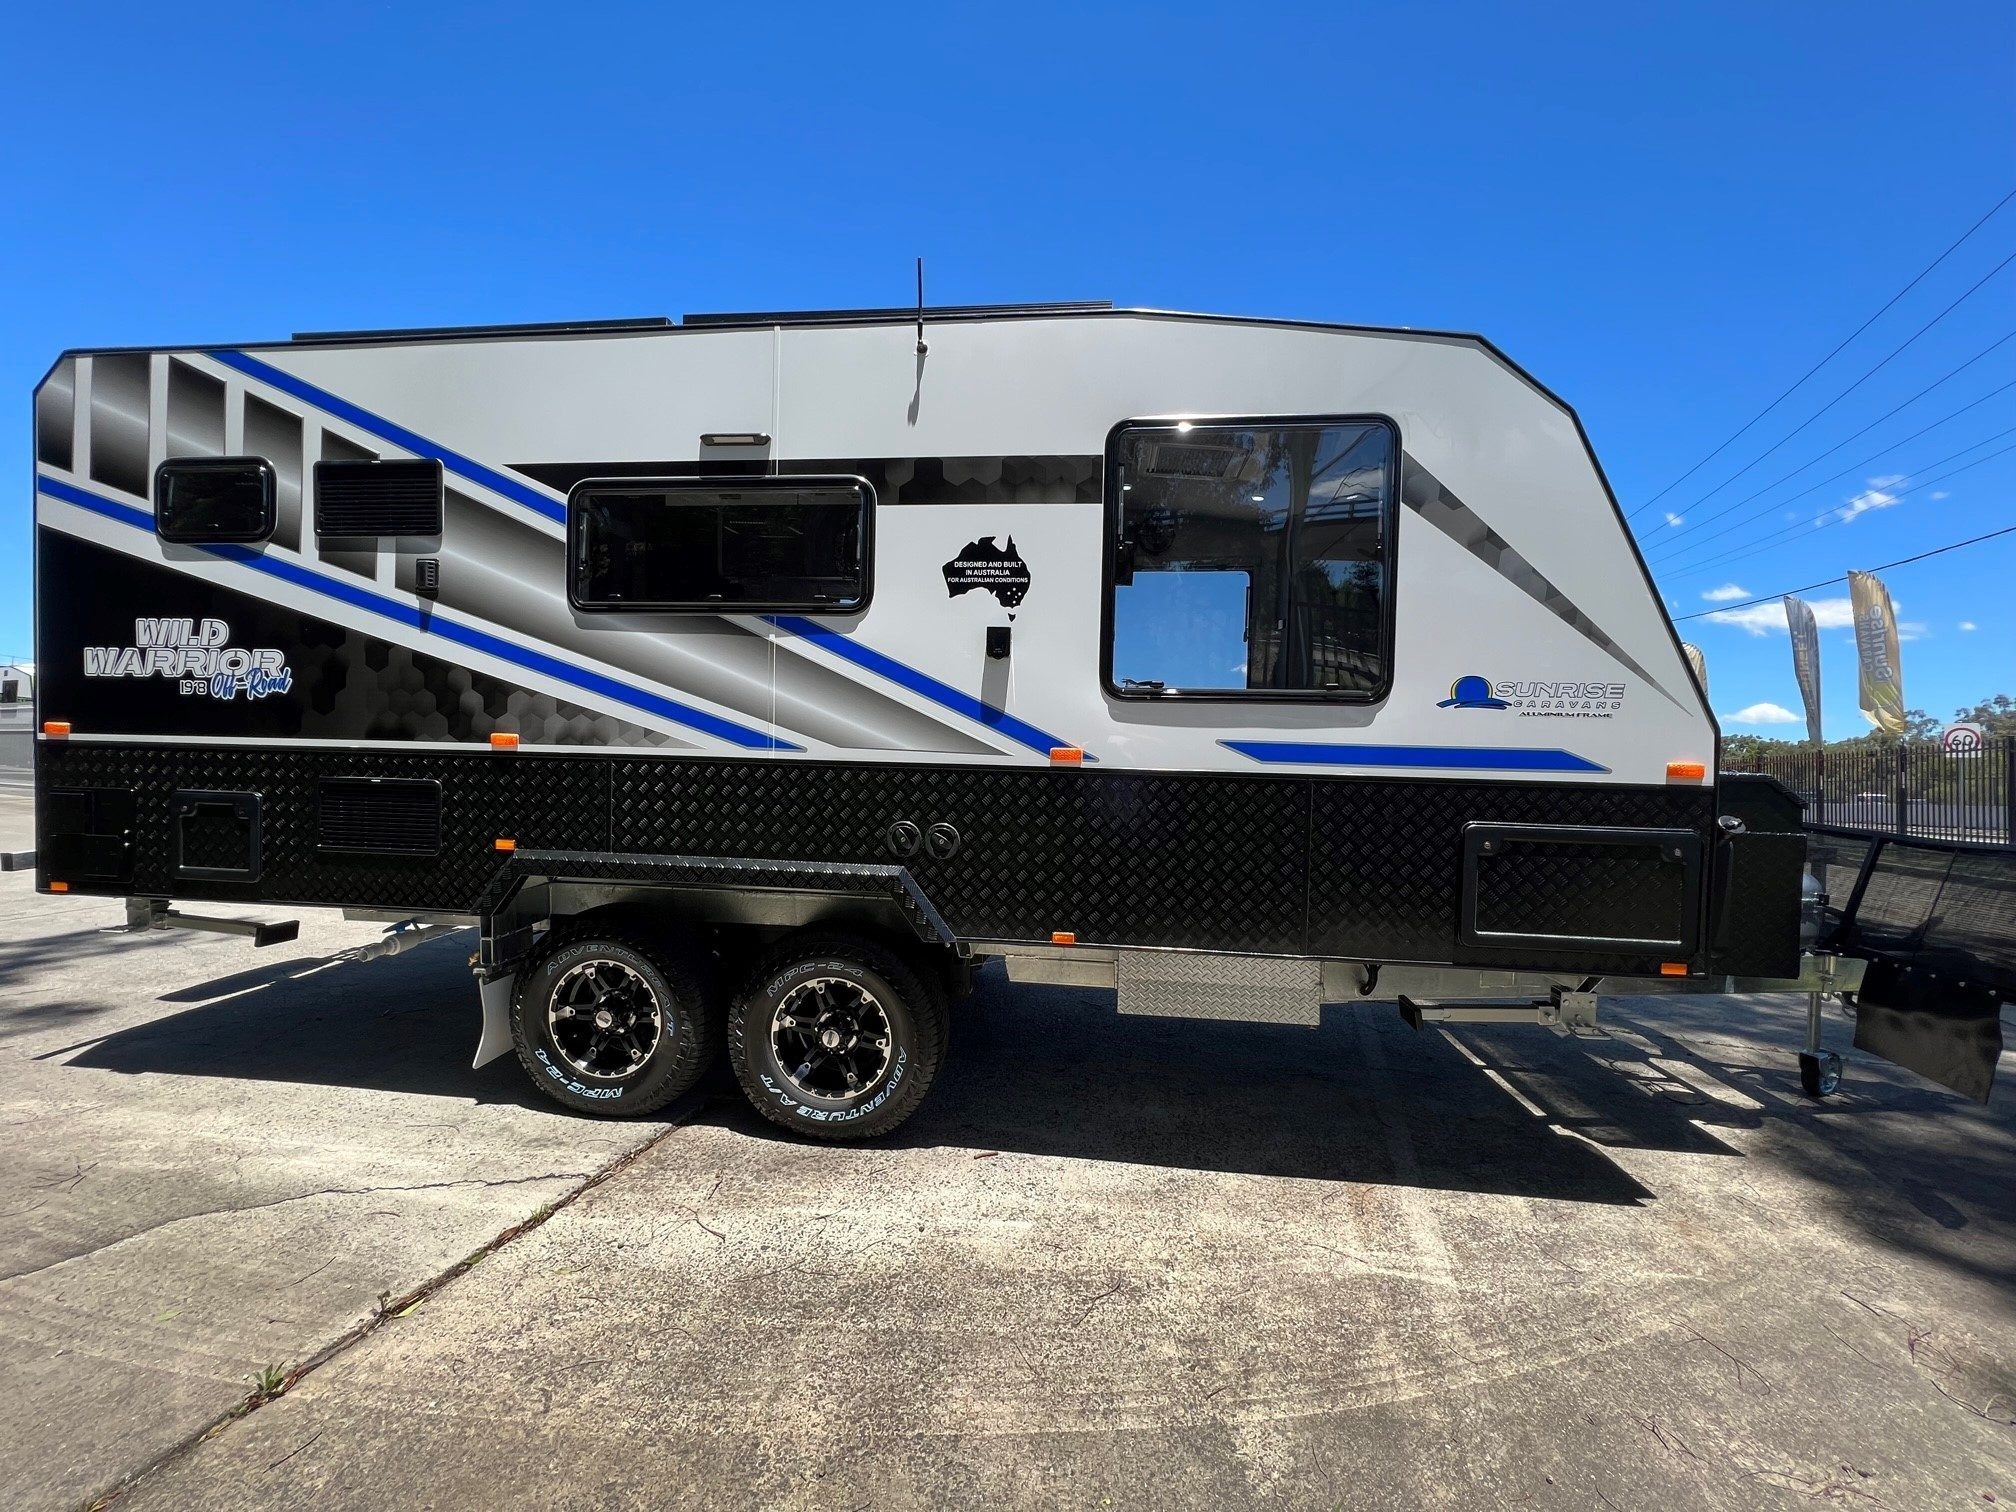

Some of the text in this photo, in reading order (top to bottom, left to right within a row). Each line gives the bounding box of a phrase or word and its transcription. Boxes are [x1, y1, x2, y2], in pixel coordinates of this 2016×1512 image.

[136, 618, 229, 648] WILD
[84, 647, 285, 678] WARRIOR
[210, 667, 292, 700] Off-Road
[1495, 681, 1626, 699] SUNRISE
[1513, 700, 1621, 709] CARAVANS
[1952, 735, 1973, 746] 60
[548, 944, 663, 988] ADVENTURE
[760, 1046, 907, 1122] ADVENTURE A/T
